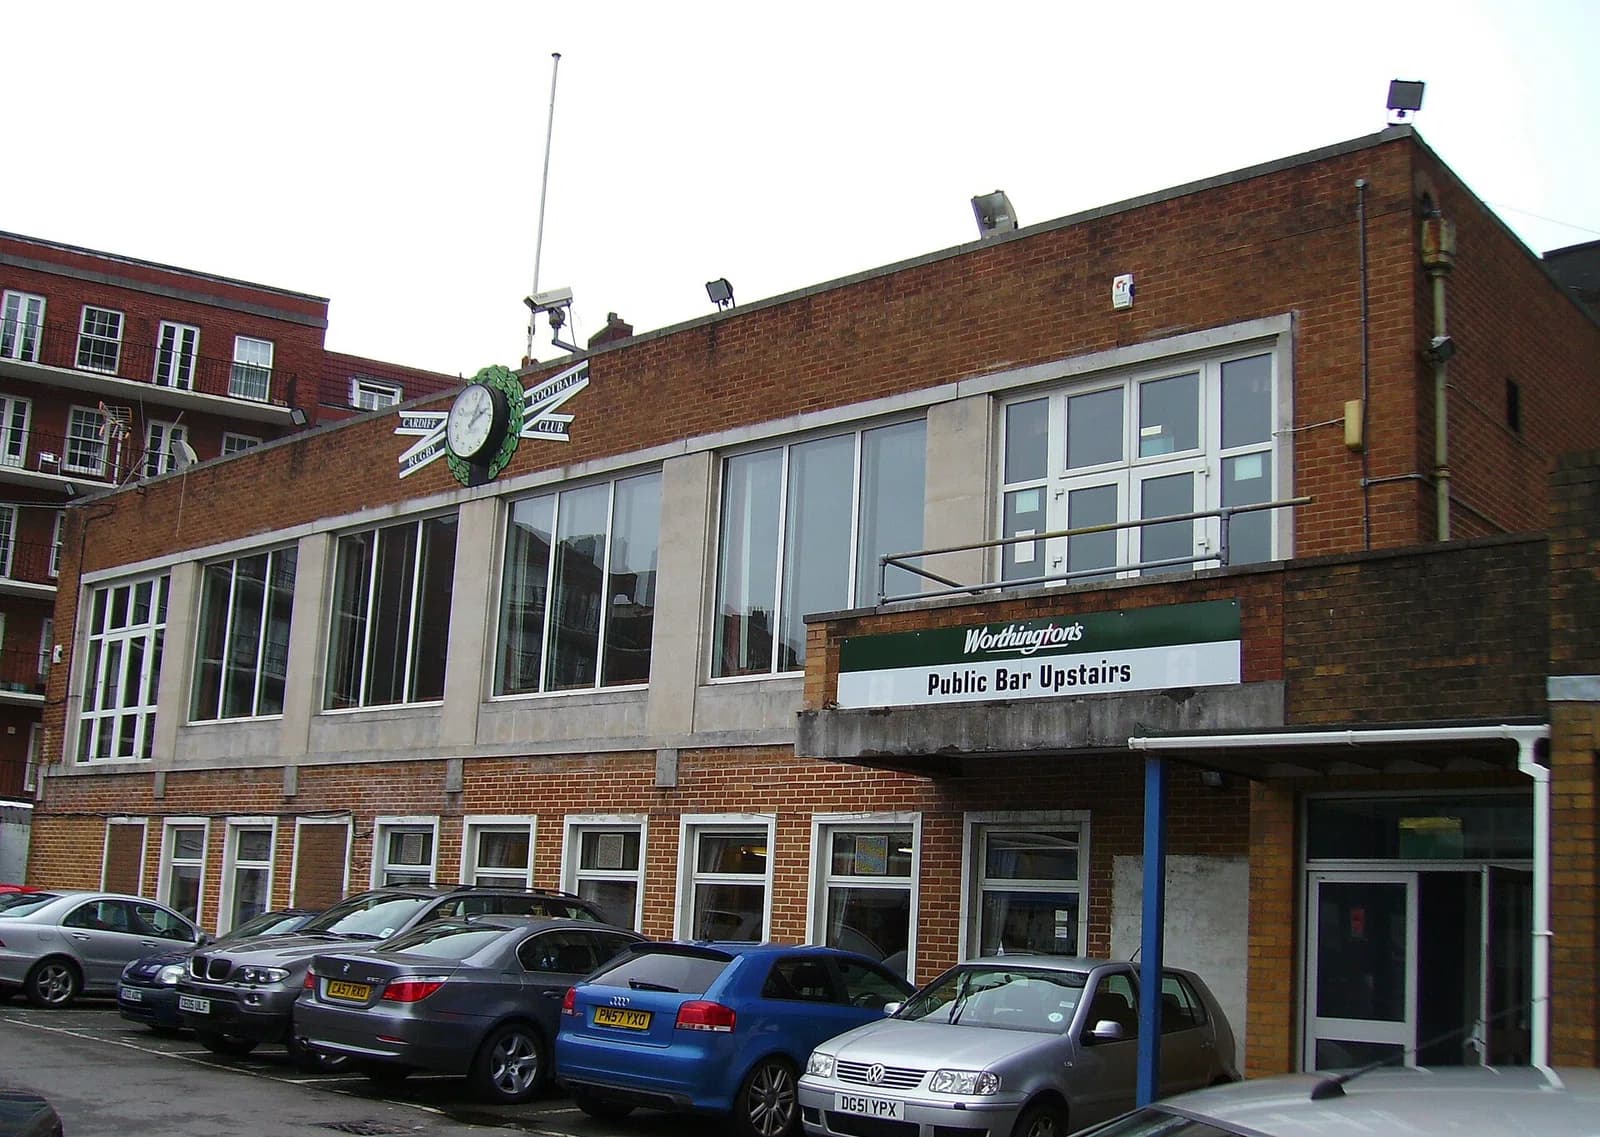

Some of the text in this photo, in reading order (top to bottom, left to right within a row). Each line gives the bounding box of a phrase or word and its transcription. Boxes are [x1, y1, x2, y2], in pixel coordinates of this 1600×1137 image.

[531, 371, 582, 405] FOOTBALL
[402, 418, 437, 428] CARDIFF
[538, 421, 565, 433] CLUB
[408, 444, 436, 467] RUGBY
[963, 622, 1084, 655] Worthington's
[928, 660, 1131, 696] Public Bar Upstairs
[598, 1008, 625, 1024] PN57
[841, 1095, 897, 1117] DG51 YPX
